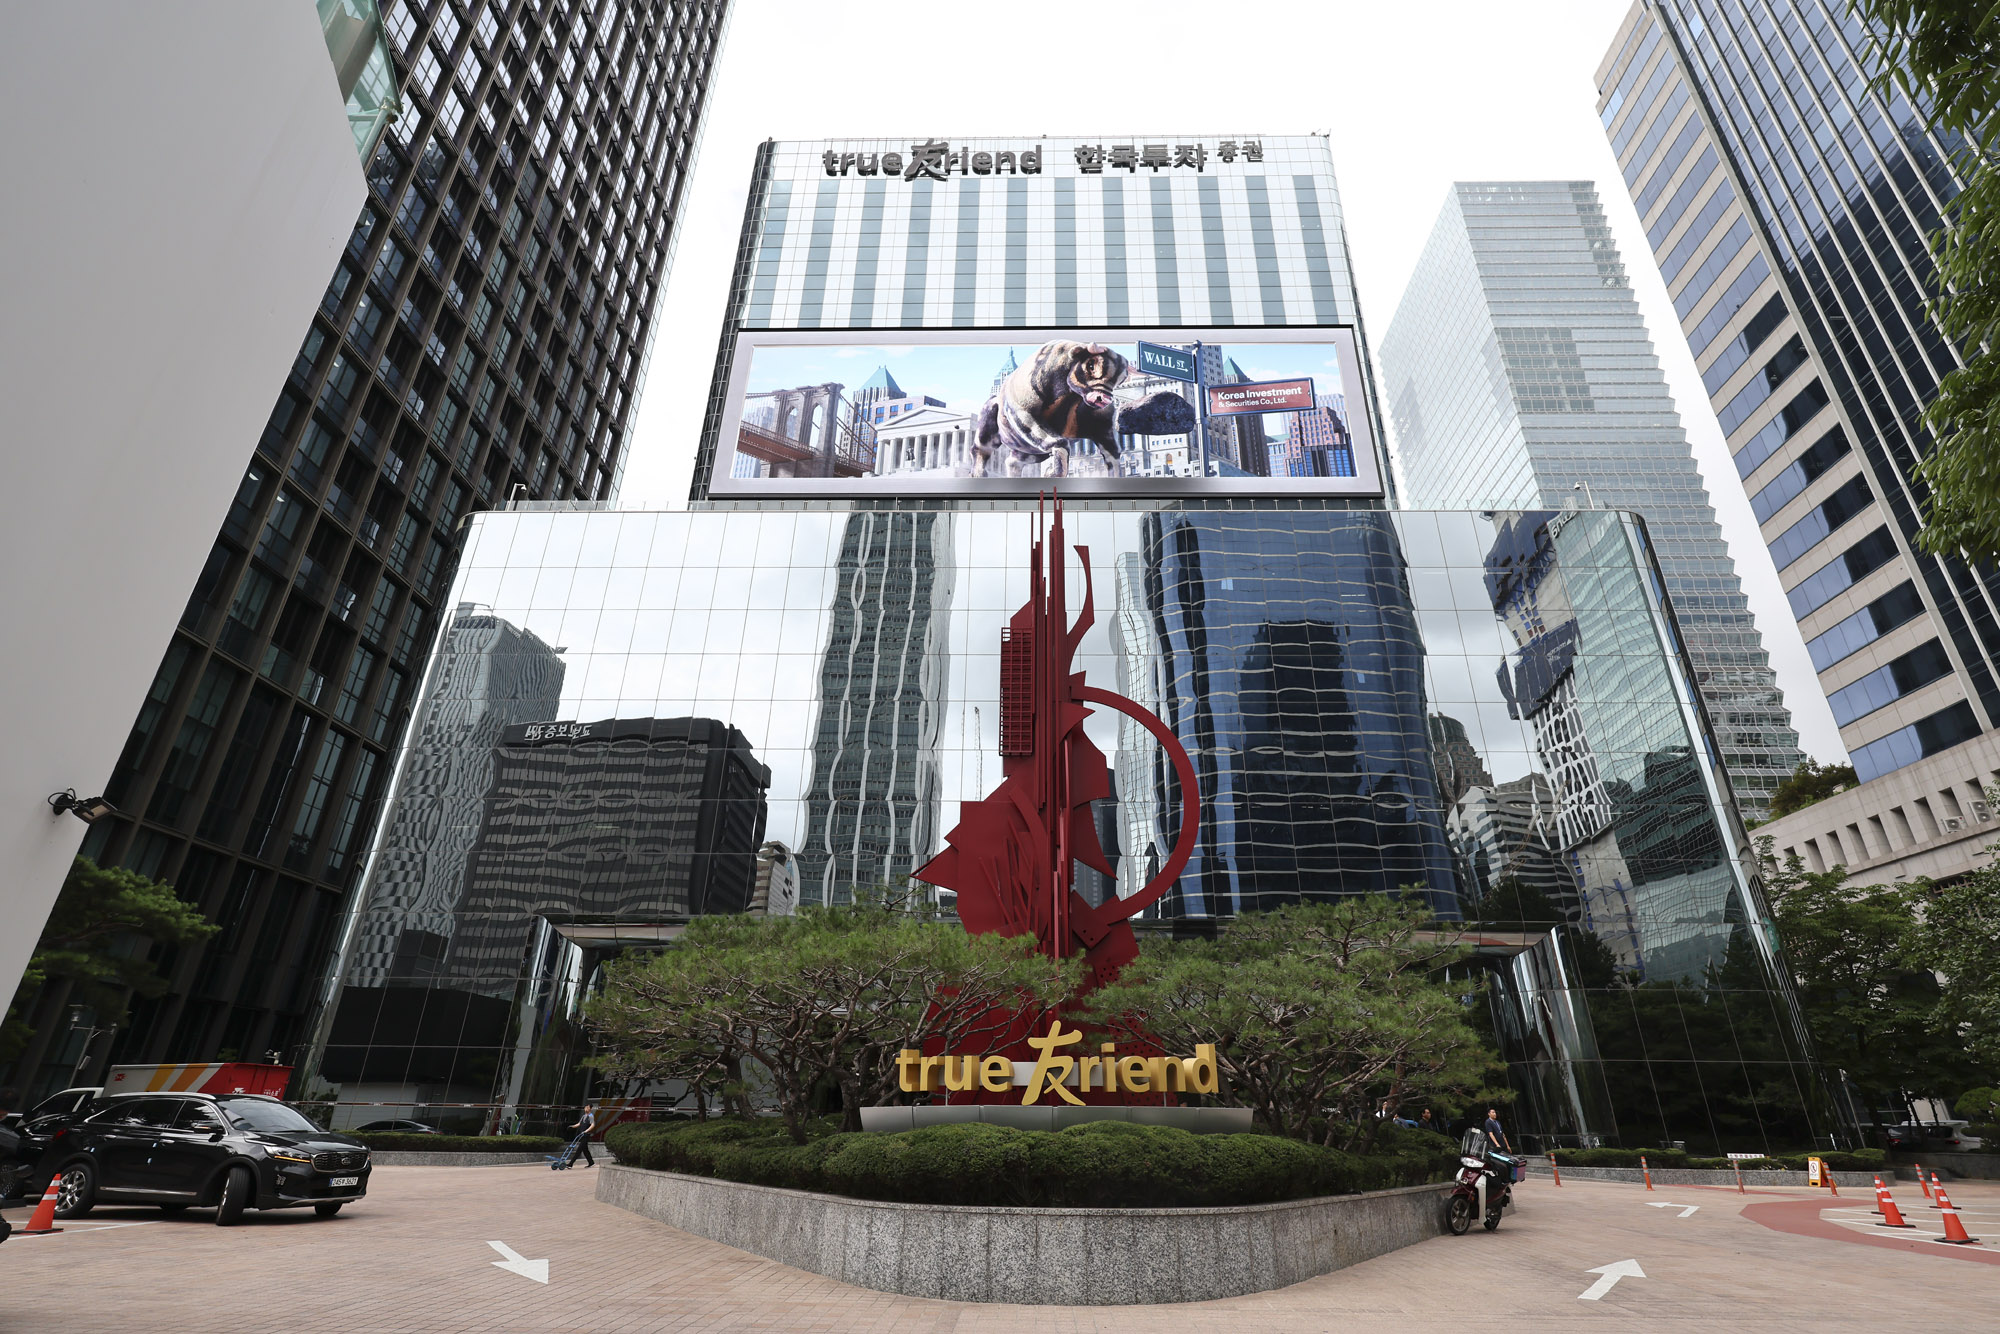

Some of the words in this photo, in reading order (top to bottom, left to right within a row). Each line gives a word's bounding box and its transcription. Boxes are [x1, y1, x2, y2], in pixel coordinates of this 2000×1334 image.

[1143, 351, 1176, 369] WALL
[1217, 391, 1245, 400] Korea
[1246, 386, 1302, 399] Investment
[1225, 399, 1260, 408] Securities
